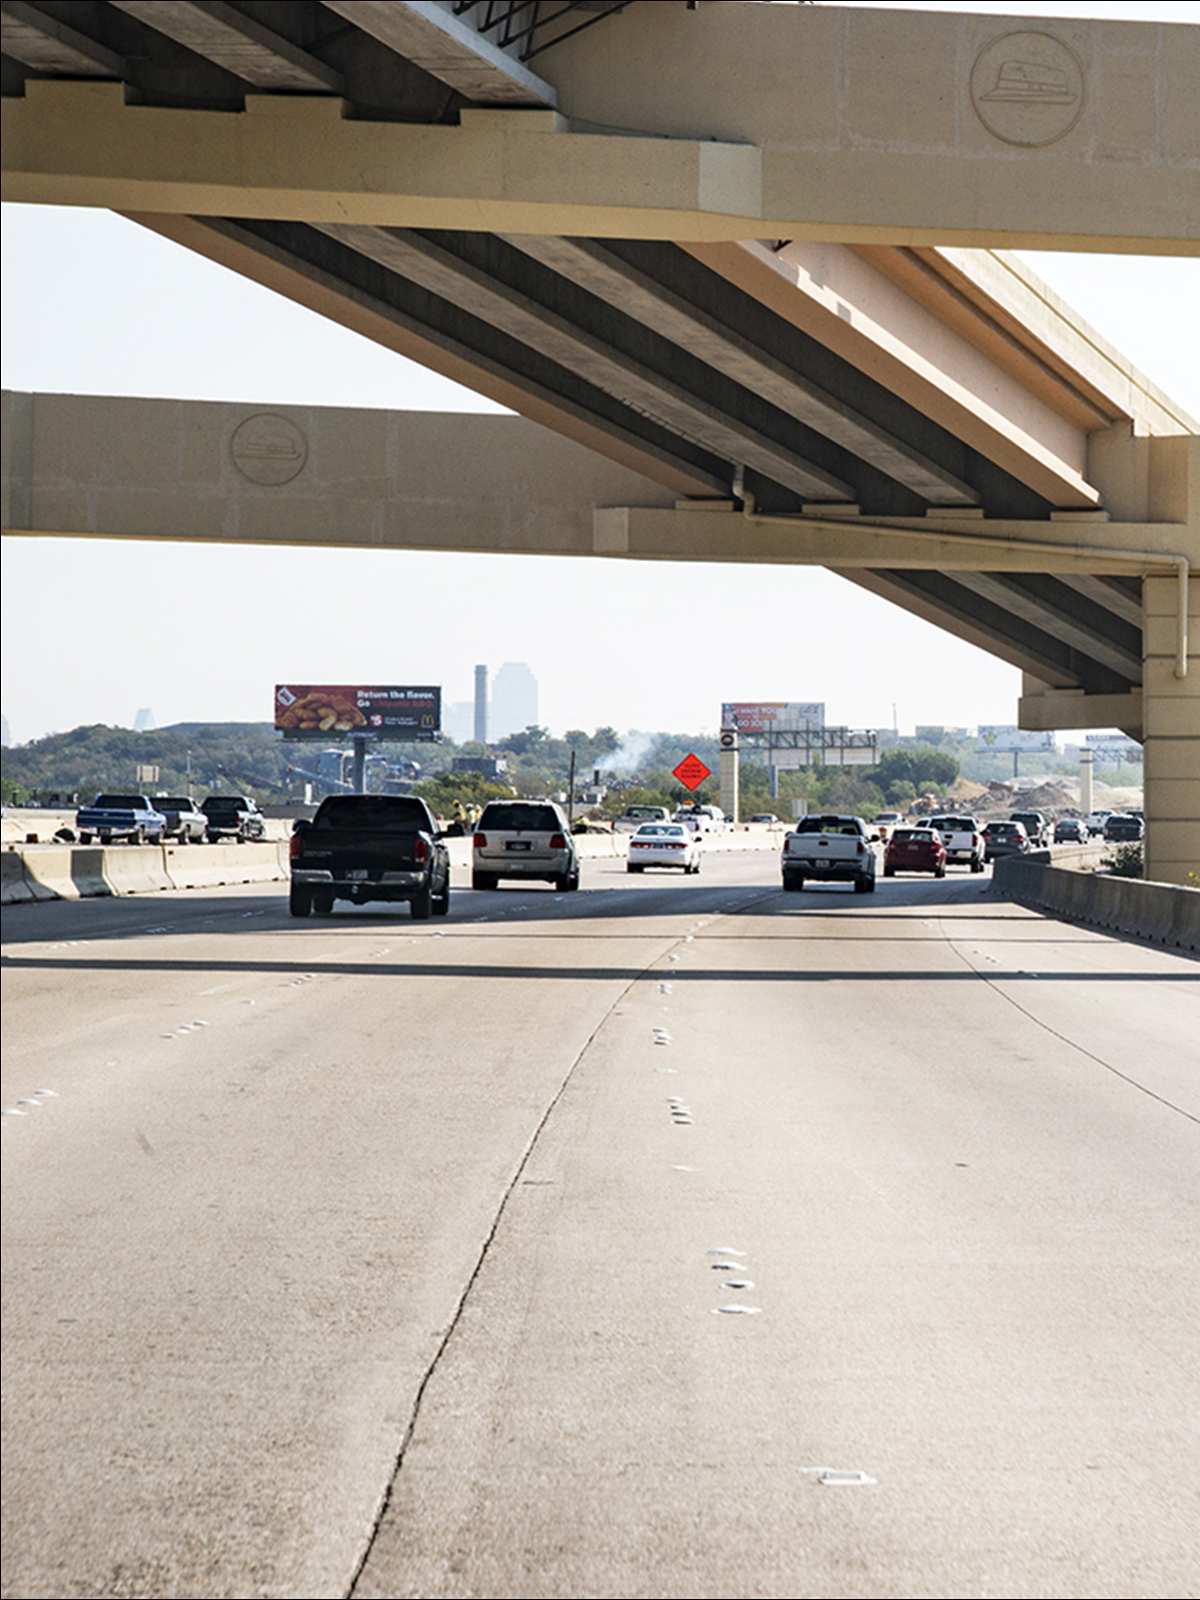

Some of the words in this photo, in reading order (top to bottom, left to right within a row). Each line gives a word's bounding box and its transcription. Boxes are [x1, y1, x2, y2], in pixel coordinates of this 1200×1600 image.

[356, 690, 388, 699] Return
[390, 690, 405, 699] the
[356, 699, 371, 708] Go
